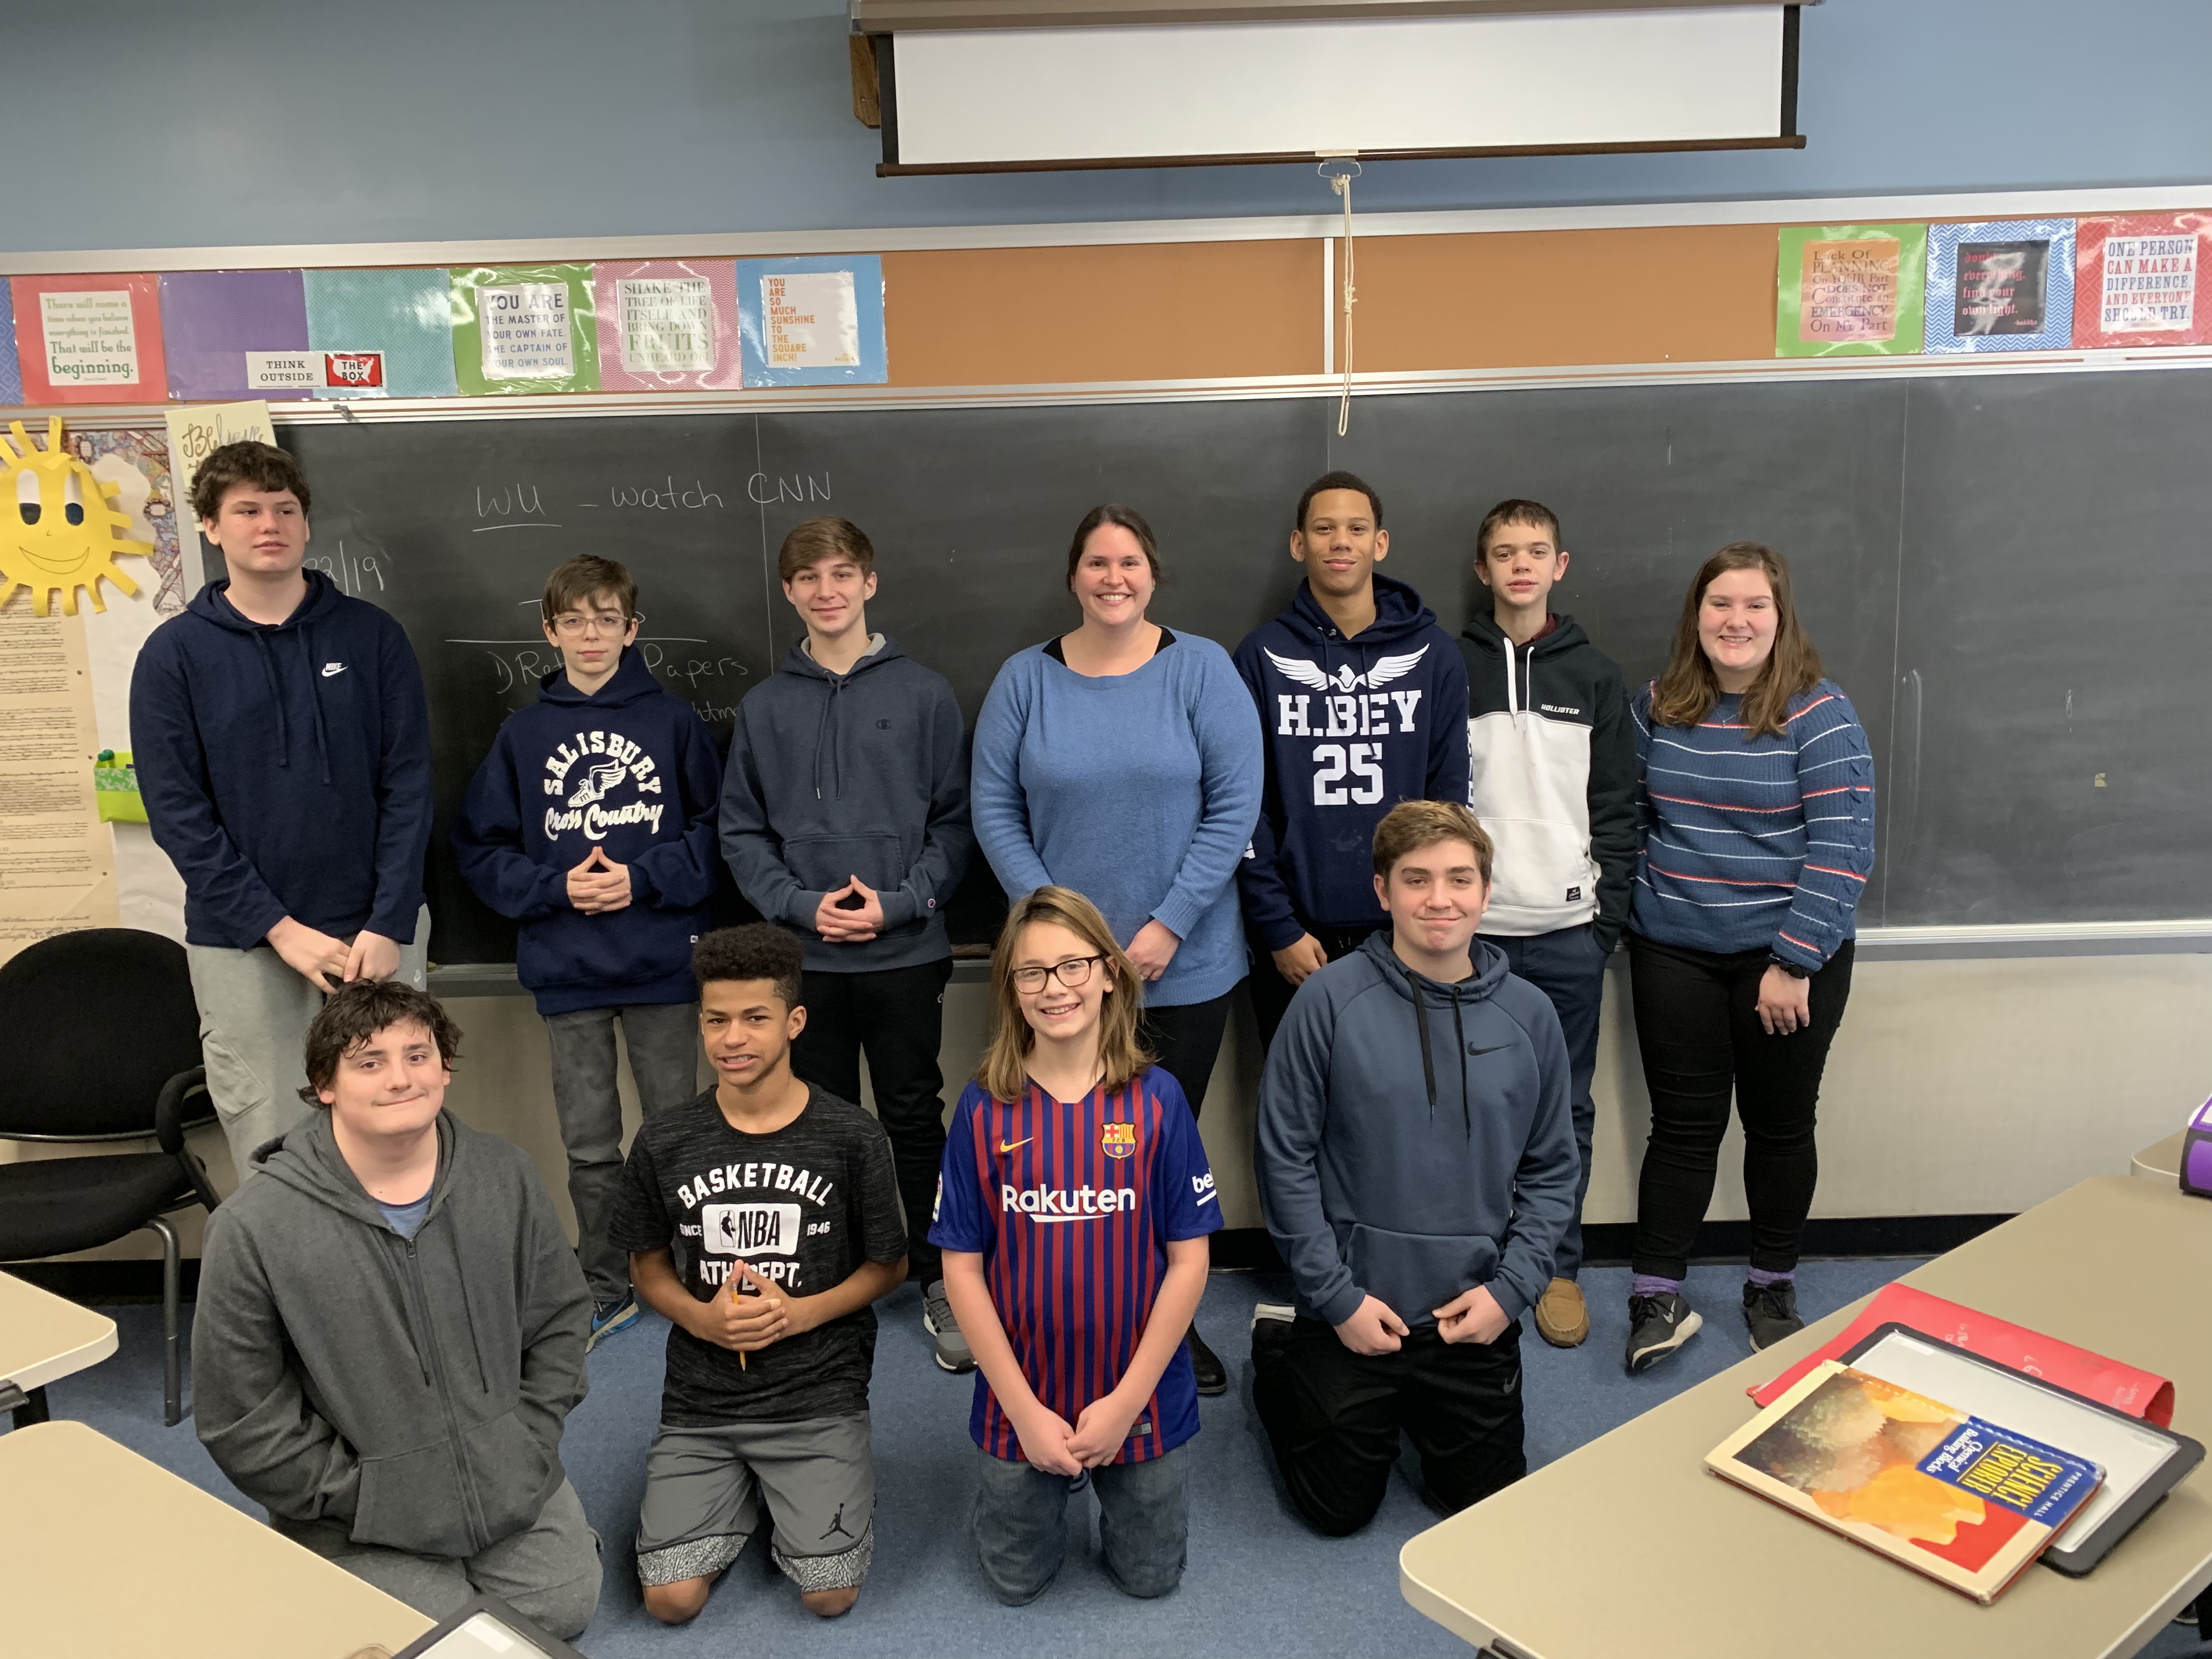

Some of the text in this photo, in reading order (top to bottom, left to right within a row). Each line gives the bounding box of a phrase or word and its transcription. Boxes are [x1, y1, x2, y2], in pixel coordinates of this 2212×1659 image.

[2109, 239, 2194, 257] ONE PERSON
[1814, 250, 1873, 261] Lack Of
[1813, 259, 1891, 273] PLANNING
[2108, 257, 2192, 274] CAN MAKE A
[768, 278, 785, 287] YOU
[1813, 273, 1889, 284] On YOUR Part
[624, 281, 706, 295] SHAKE THE
[769, 287, 786, 297] ARE
[1827, 284, 1889, 293] DOES NOT
[1963, 286, 1986, 298] find
[45, 297, 74, 311] There
[76, 297, 93, 308] will
[486, 294, 563, 311] YOU ARE
[625, 295, 707, 307] TREE OF LIFE
[769, 297, 781, 306] SO
[1877, 294, 1889, 302] an
[2106, 291, 2191, 306] AND EVERYONE
[627, 308, 707, 321] ITSELF AND
[770, 306, 796, 315] MUCH
[1811, 304, 1888, 318] EMERGENCY
[1962, 307, 1986, 316] own
[2161, 305, 2190, 320] TRY.
[47, 312, 128, 325] time when you believe
[486, 313, 565, 325] THE MASTER OF
[771, 315, 815, 325] SUNSHINE
[1810, 319, 1830, 332] On
[1861, 318, 1887, 331] Part
[49, 327, 88, 339] everything
[90, 326, 98, 336] is
[628, 320, 707, 332] BRING DOWN
[771, 325, 782, 335] TO
[516, 329, 536, 338] OWN
[772, 335, 788, 343] THE
[50, 340, 132, 354] That will be the
[488, 342, 567, 354] THE CAPTAIN OF
[628, 333, 709, 351] FRUITS
[772, 343, 806, 353] SQUARE
[517, 358, 539, 367] OWN
[543, 357, 568, 366] SOUL.
[773, 353, 797, 362] INCH!
[52, 356, 133, 380] beginning.
[266, 360, 306, 369] THINK
[342, 361, 363, 370] THE
[260, 373, 314, 382] OUTSIDE
[342, 371, 364, 381] BOX
[476, 483, 546, 518] WU
[612, 476, 724, 510] watch
[748, 472, 832, 504] CNN
[644, 643, 748, 689] Papers
[1278, 689, 1423, 737] H.BEY
[1541, 703, 1580, 715] HOLLISTER
[544, 731, 662, 796] SALISBURY
[1312, 742, 1384, 805] 25
[544, 800, 664, 841] Cross Country
[678, 1163, 833, 1210] BASKETBALL
[1002, 1183, 1136, 1214] Rakuten
[679, 1223, 703, 1237] SINCE
[737, 1210, 780, 1249] NBA
[807, 1221, 831, 1236] 1946
[1926, 1428, 1979, 1474] Building Blocks
[1948, 1441, 1984, 1473] Chemical
[1962, 1443, 2028, 1494] EXPLORER
[1990, 1454, 2064, 1510] SCIENCE
[2034, 1472, 2083, 1517] PRENTICE HALL
